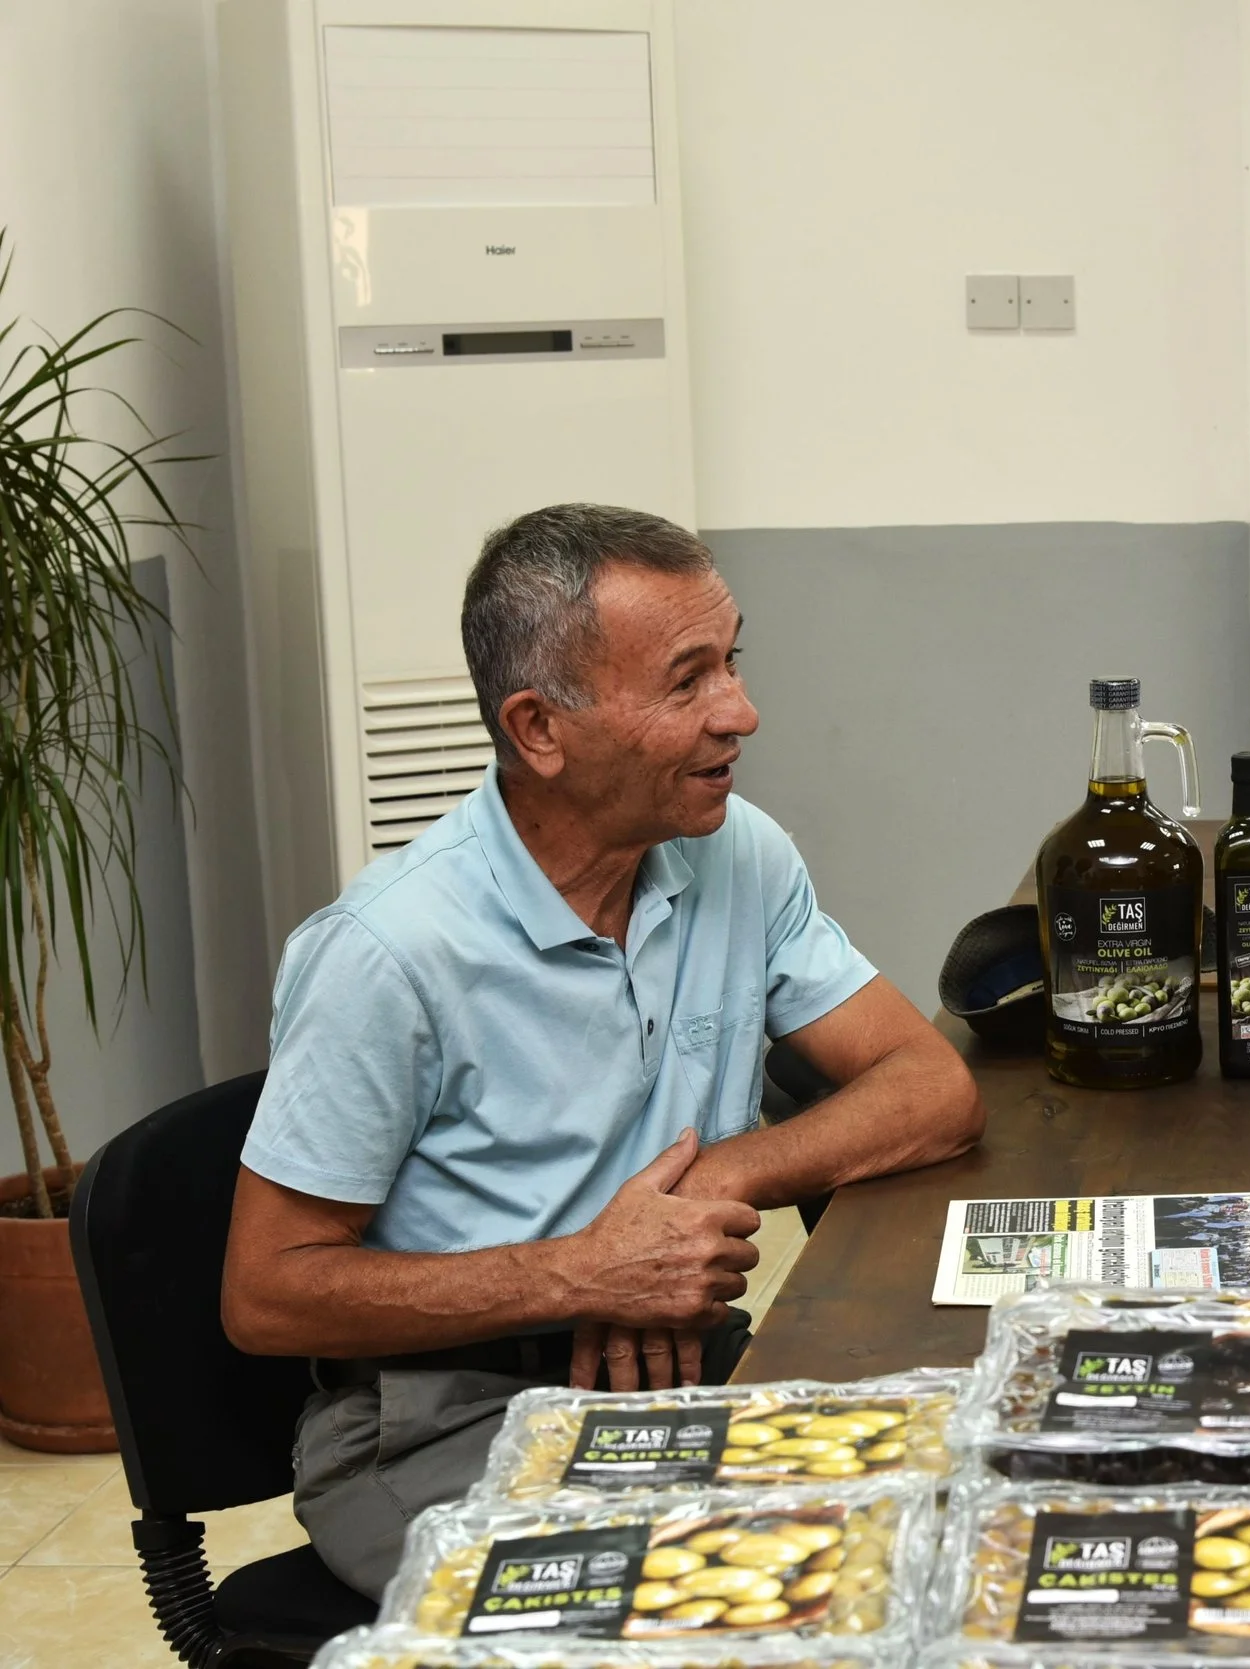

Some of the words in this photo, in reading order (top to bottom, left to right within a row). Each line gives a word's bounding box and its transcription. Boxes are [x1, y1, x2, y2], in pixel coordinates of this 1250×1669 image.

[486, 244, 516, 256] Haier
[1118, 903, 1144, 922] TAŞ
[1108, 921, 1143, 931] DEĞİRMEN
[1098, 939, 1122, 948] EXTRA
[1125, 938, 1151, 948] VIRGIN
[1098, 948, 1131, 957] OLIVE
[1133, 948, 1152, 957] OIL
